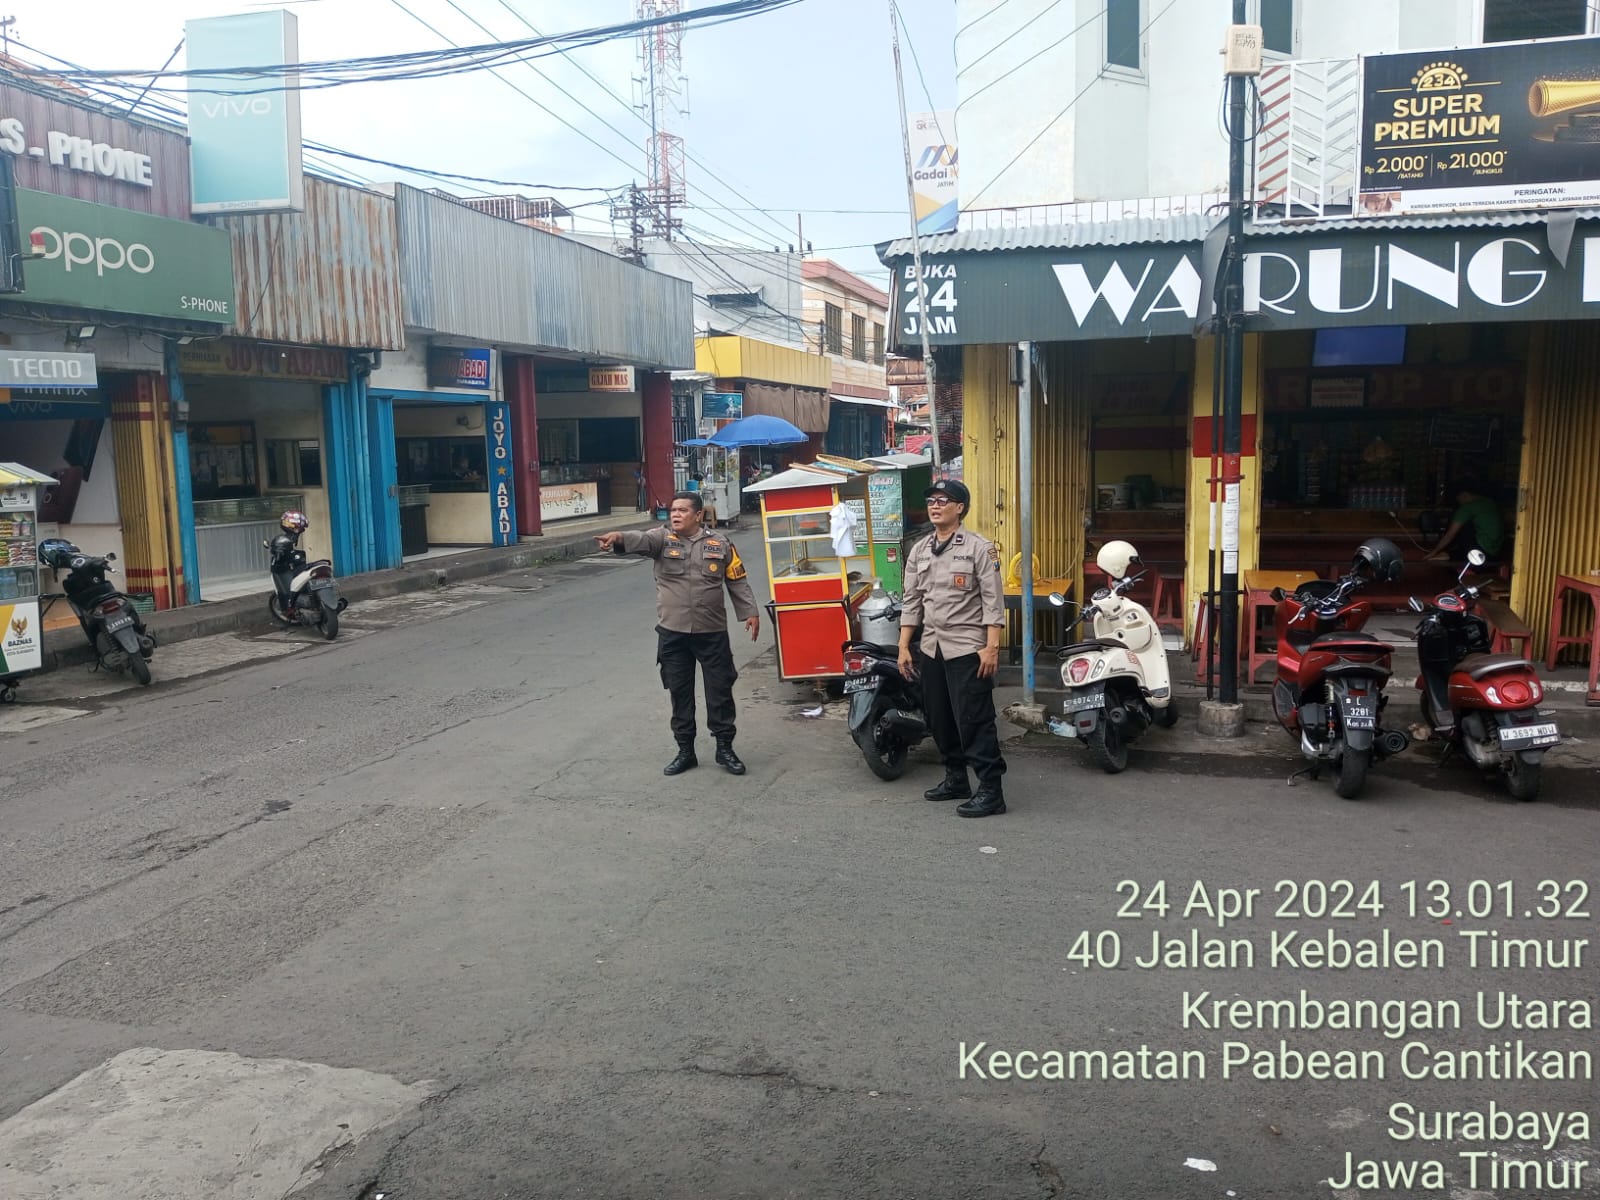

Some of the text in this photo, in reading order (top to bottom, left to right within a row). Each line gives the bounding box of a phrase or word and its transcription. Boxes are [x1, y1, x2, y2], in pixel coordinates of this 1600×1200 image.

[1421, 74, 1456, 91] 234
[201, 98, 272, 119] vivo
[1393, 93, 1483, 117] SUPER
[1374, 115, 1500, 142] PREMIUM
[914, 168, 948, 180] Gadai
[1364, 166, 1375, 175] Rp
[1436, 162, 1448, 171] Rp
[1514, 187, 1566, 196] PERINGATAN:
[904, 264, 957, 279] BUKA
[1051, 238, 1548, 328] WARUNG
[180, 295, 228, 315] S-PHONE
[904, 279, 958, 313] 24
[903, 316, 957, 335] JAM
[8, 358, 81, 378] TECNO
[457, 359, 487, 379] ABADI
[614, 374, 628, 385] MAS
[493, 408, 506, 459] JOYO
[497, 482, 511, 546] ABADI
[8, 638, 33, 647] BAZNAS
[1350, 707, 1369, 716] 3281
[1502, 731, 1510, 740] W
[1512, 728, 1534, 738] 3692
